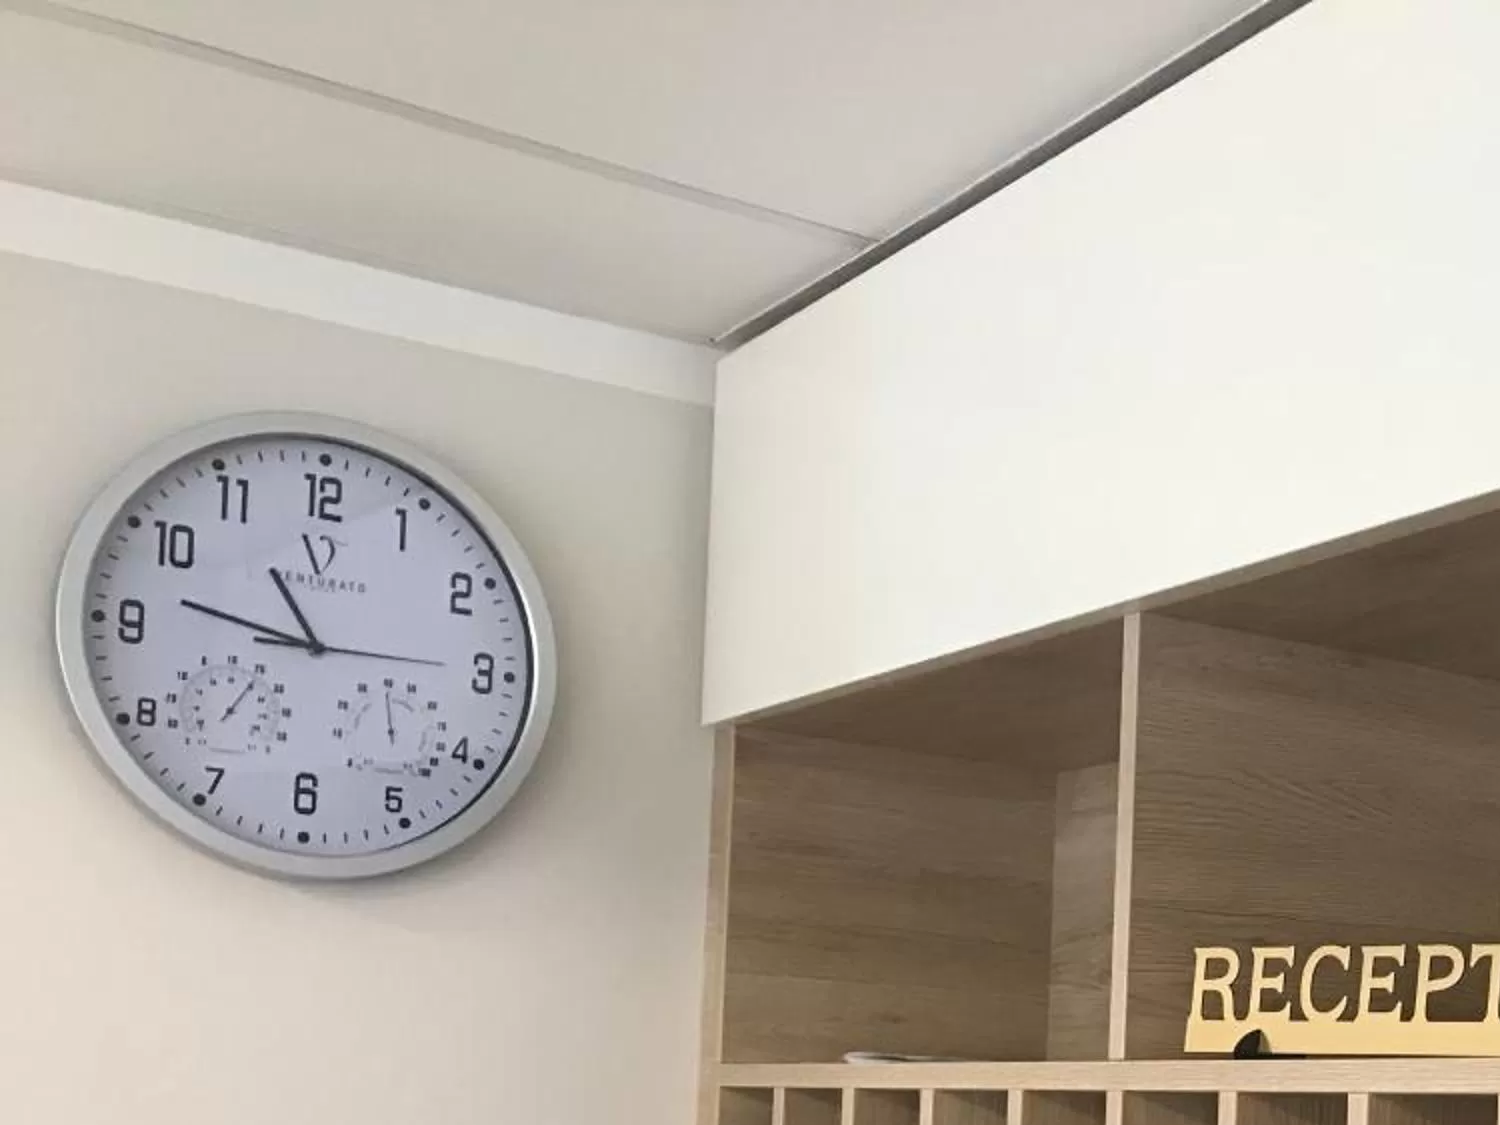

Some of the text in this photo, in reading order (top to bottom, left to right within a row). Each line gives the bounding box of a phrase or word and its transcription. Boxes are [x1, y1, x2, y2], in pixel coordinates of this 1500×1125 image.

[216, 476, 249, 524] 11
[305, 474, 343, 522] 12
[154, 521, 195, 569] 10
[394, 508, 407, 552] 1
[272, 569, 366, 594] ENTURATO
[450, 572, 472, 616] 2
[118, 600, 145, 644] 9
[472, 652, 494, 694] 3
[136, 697, 156, 726] 8
[451, 737, 468, 764] 4
[205, 767, 225, 795] 7
[294, 773, 318, 815] 6
[384, 787, 403, 813] 5
